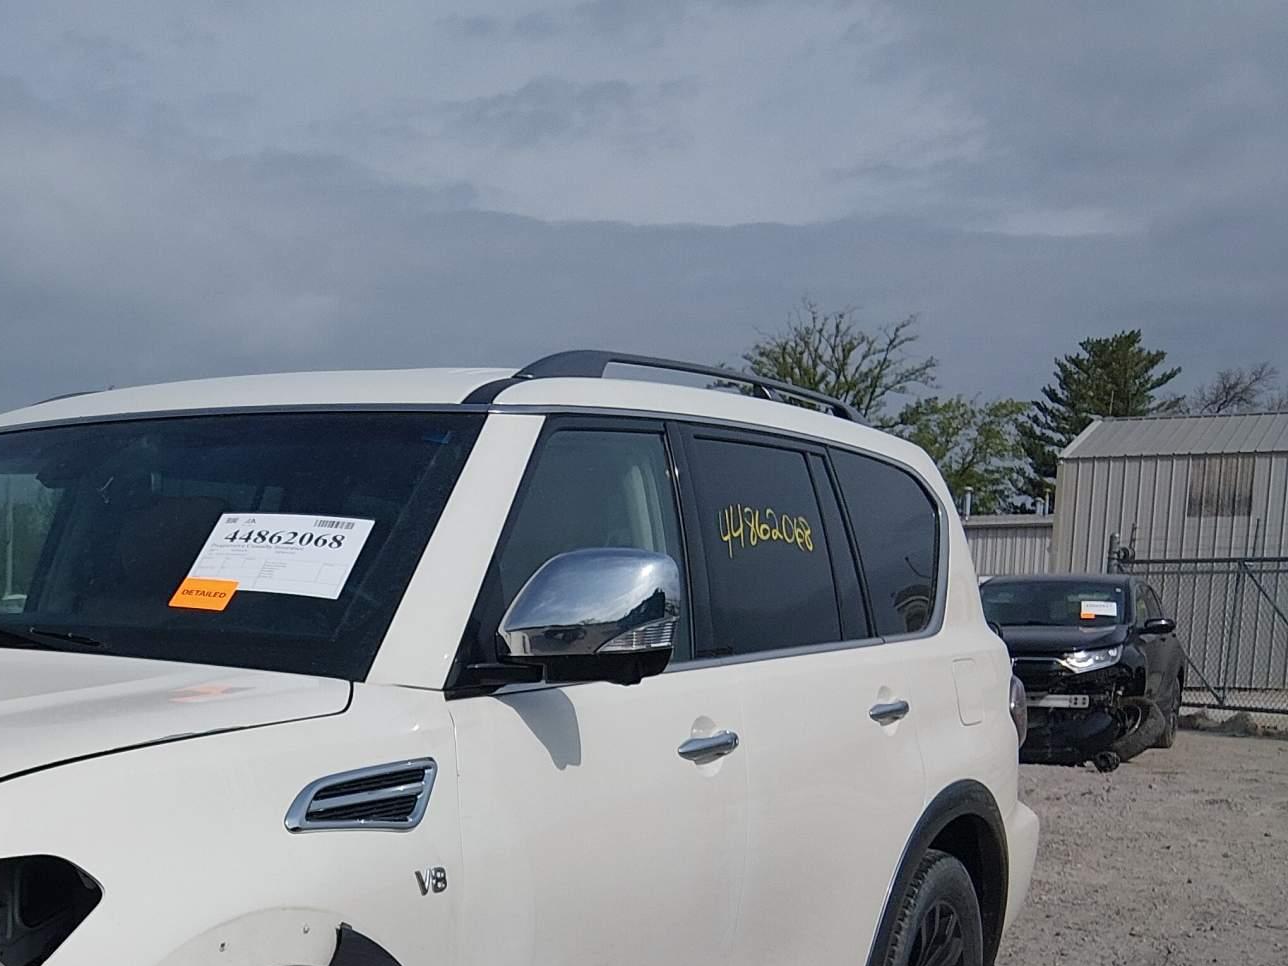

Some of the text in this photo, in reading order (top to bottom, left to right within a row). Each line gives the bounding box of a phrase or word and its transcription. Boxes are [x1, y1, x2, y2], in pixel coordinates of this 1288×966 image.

[224, 528, 346, 550] 44862068
[718, 503, 814, 558] 44862068
[182, 588, 227, 599] DETAILED
[414, 866, 448, 896] V8
